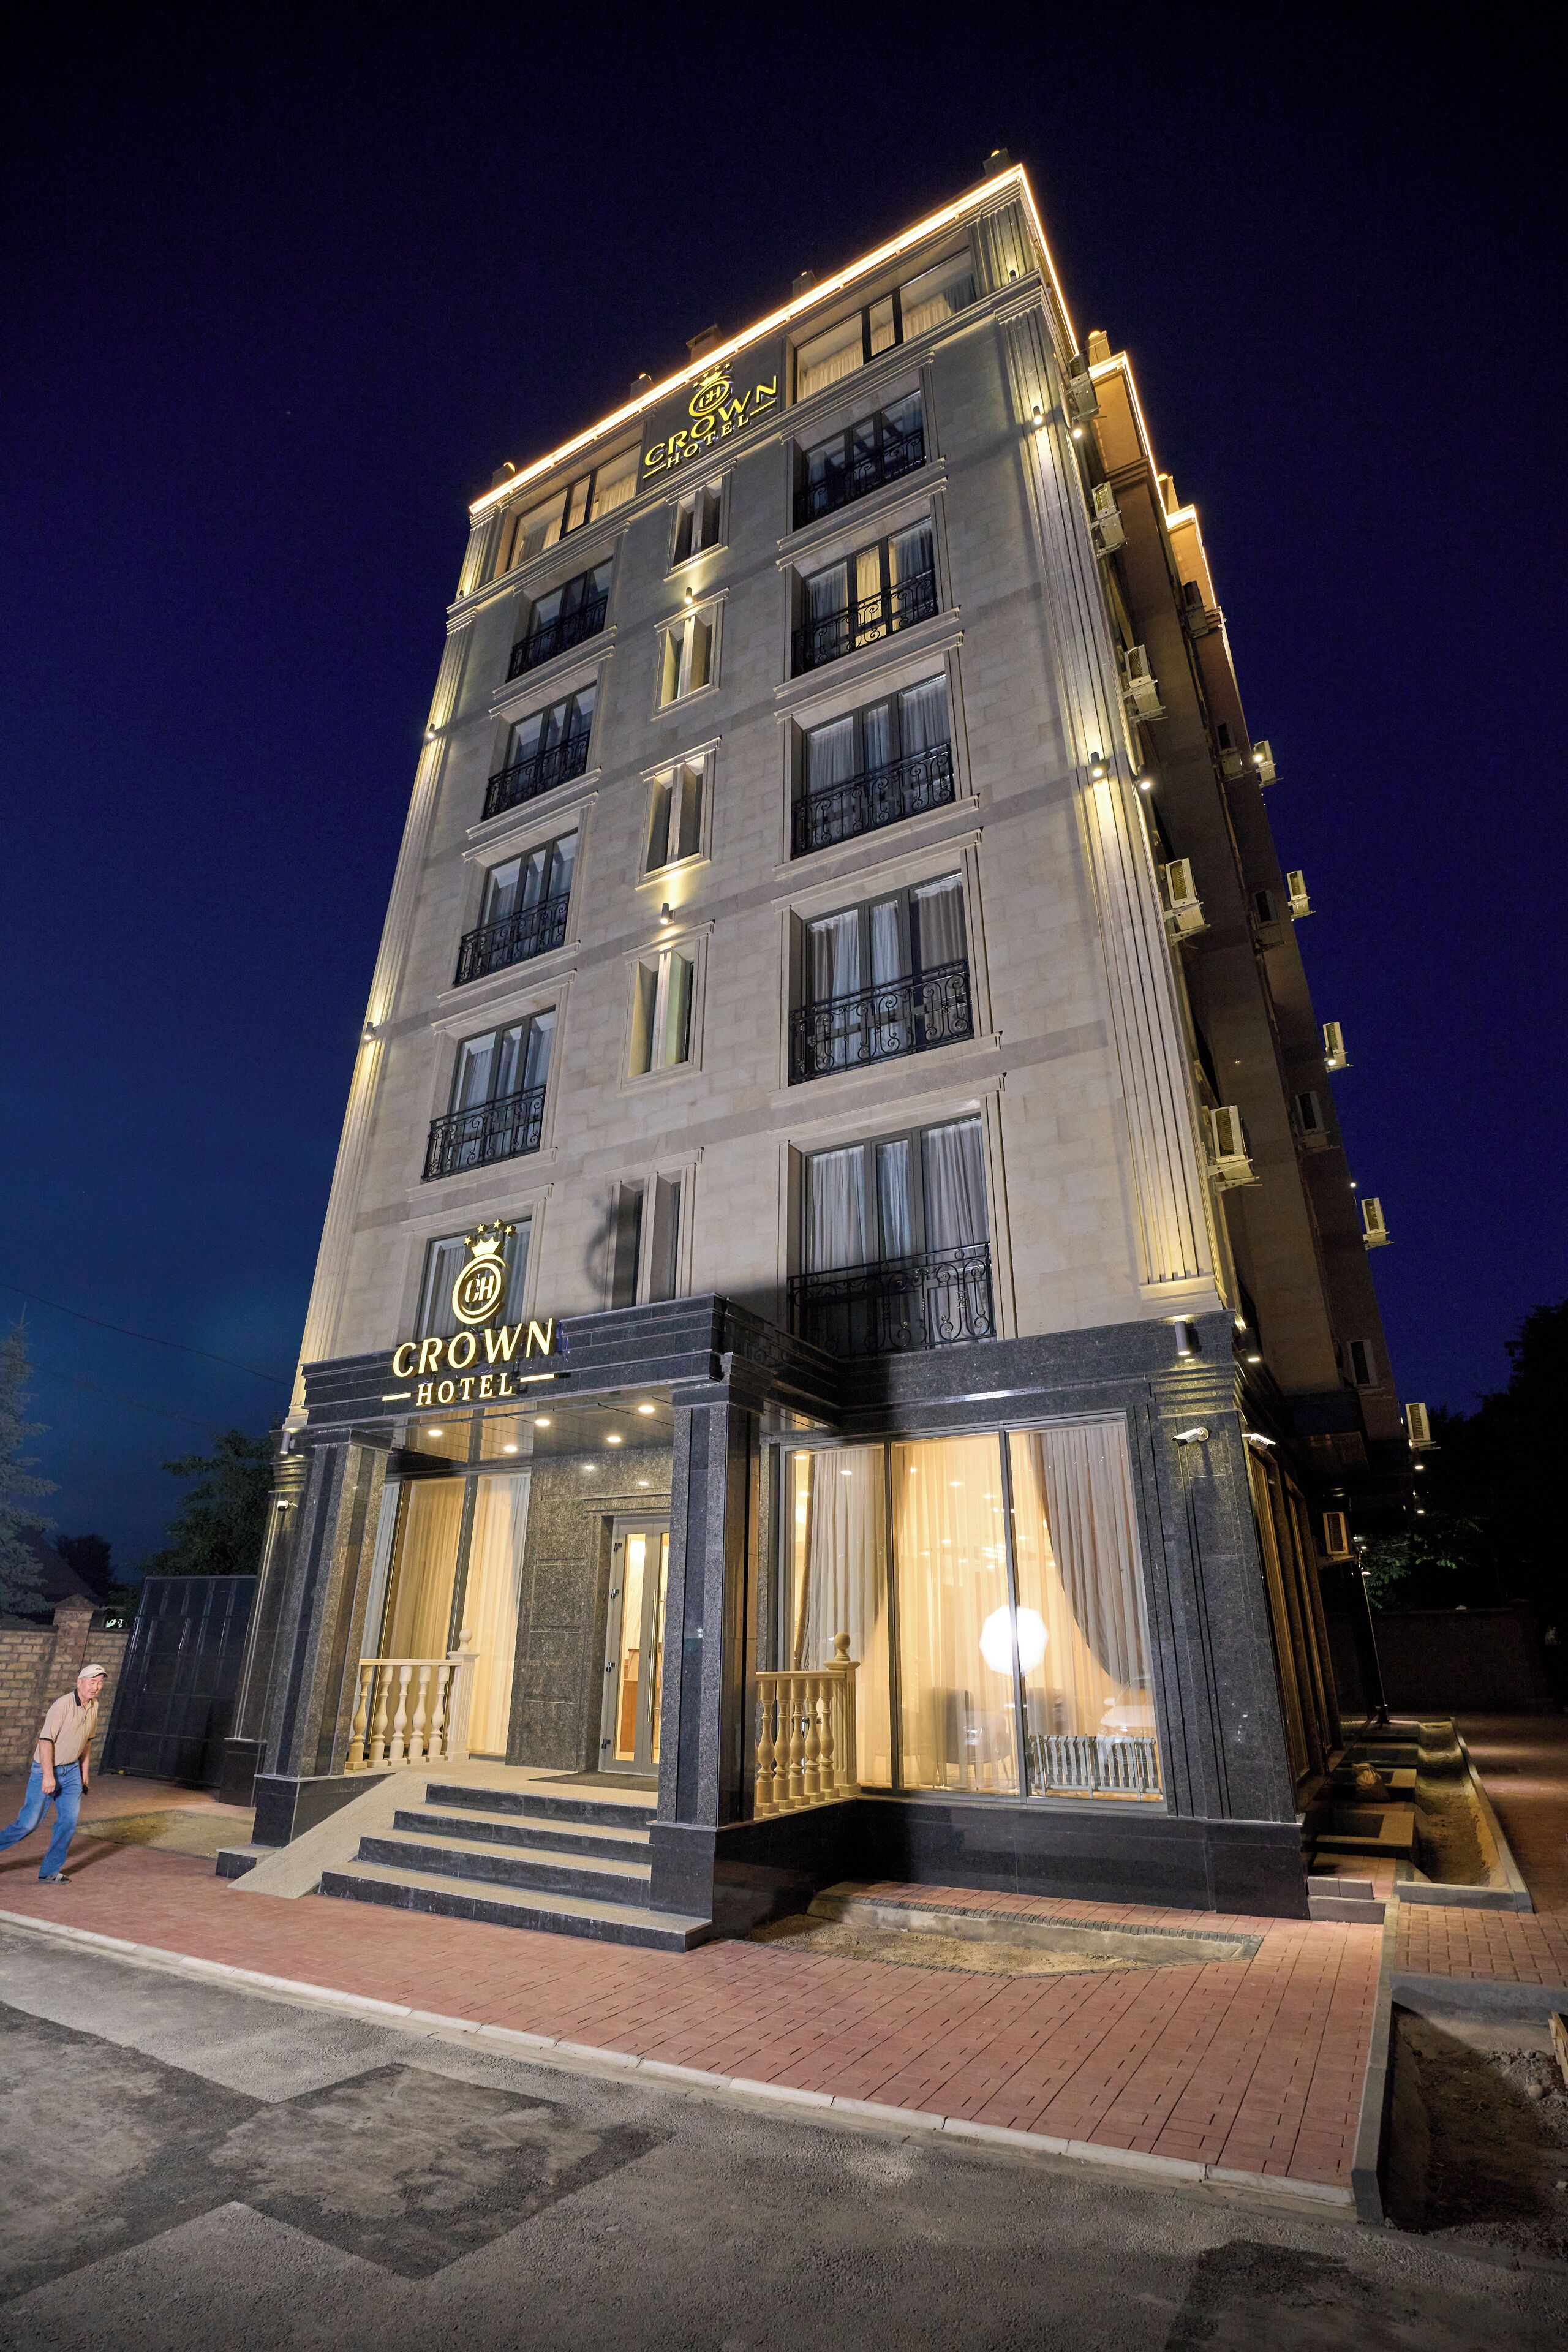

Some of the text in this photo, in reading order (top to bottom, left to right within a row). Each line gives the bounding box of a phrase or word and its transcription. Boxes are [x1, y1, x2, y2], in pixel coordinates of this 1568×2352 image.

[699, 386, 720, 409] CH
[644, 375, 777, 466] CROWN
[666, 415, 749, 469] HOTEL
[465, 1275, 494, 1303] CH
[393, 1318, 553, 1378] CROWN
[417, 1372, 513, 1406] HOTEL
